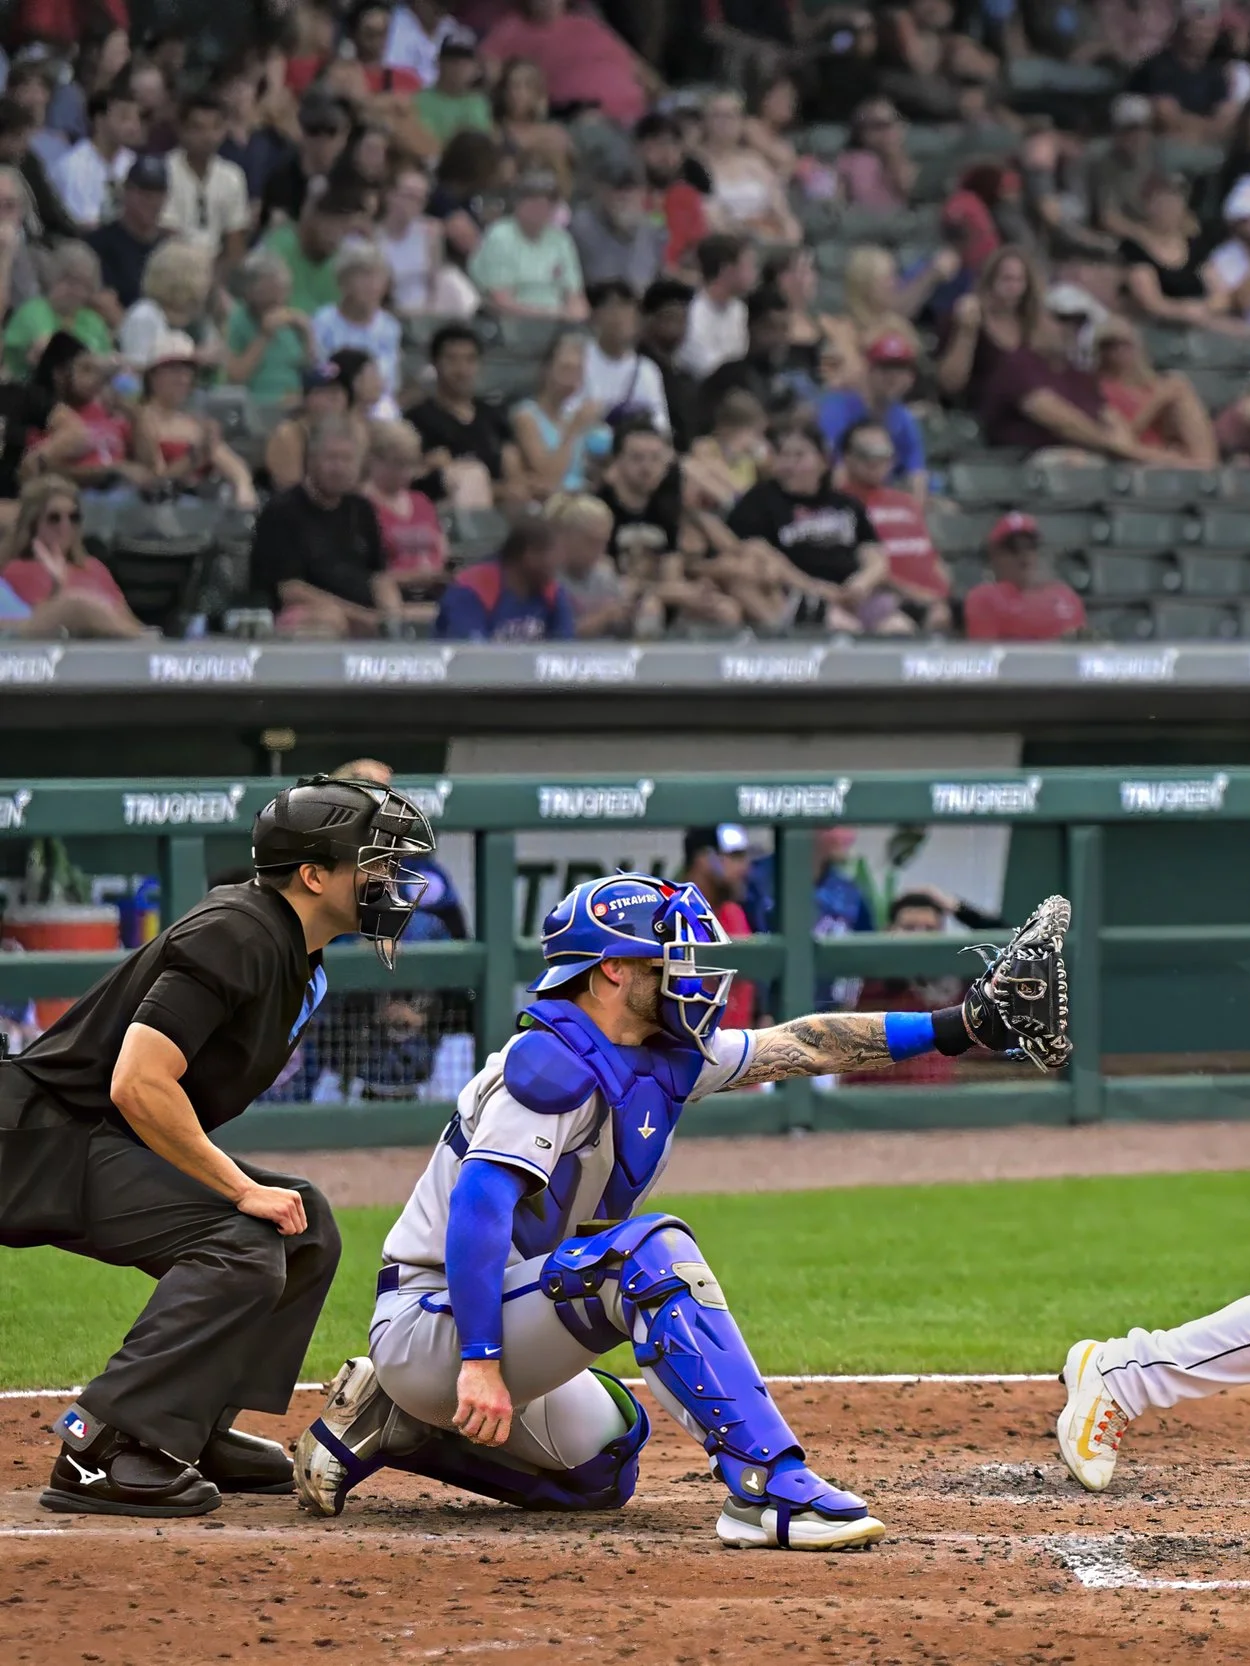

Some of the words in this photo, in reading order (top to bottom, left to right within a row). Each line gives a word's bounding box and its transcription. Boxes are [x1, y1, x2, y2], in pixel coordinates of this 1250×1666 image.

[123, 792, 239, 825] TRUGREEN
[538, 786, 647, 819] TRUGREEN
[737, 784, 845, 818] TRUGREEN
